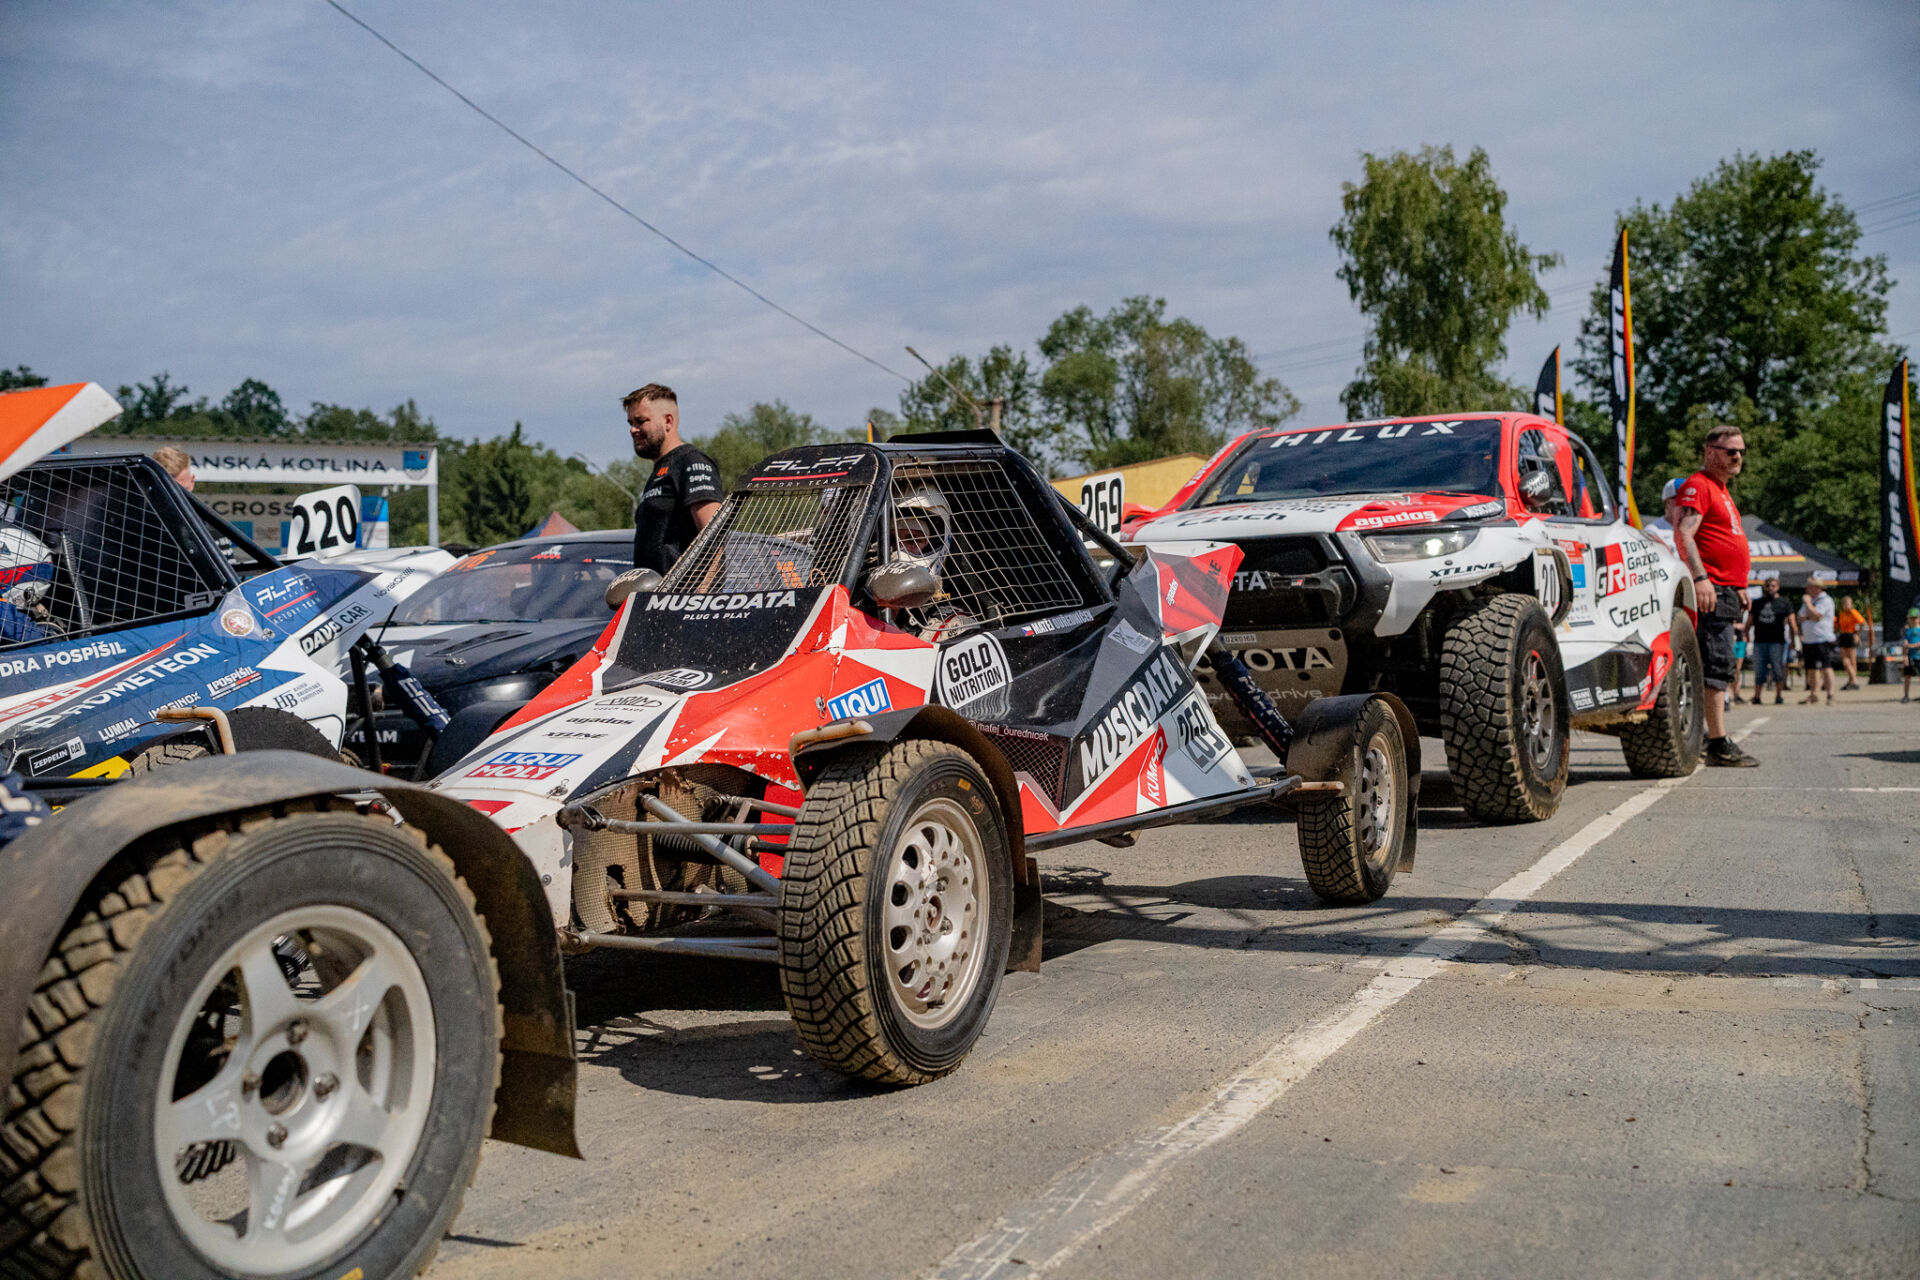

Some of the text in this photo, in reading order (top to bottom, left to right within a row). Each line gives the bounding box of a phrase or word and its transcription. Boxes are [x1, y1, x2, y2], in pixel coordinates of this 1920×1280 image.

[1270, 421, 1463, 448] HILUX
[282, 457, 387, 472] KOTLINA
[764, 454, 866, 472] ALFA
[809, 478, 839, 486] TEAM
[1081, 477, 1122, 542] 269
[1177, 512, 1287, 527] Czech
[1354, 510, 1437, 528] agados
[292, 495, 357, 555] 220
[1429, 562, 1504, 578] XTLINE
[1595, 562, 1627, 599] GR
[1629, 568, 1669, 587] Racing
[256, 573, 312, 606] ALFA
[1542, 563, 1557, 608] 20
[645, 590, 796, 611] MUSICDATA
[1609, 594, 1661, 628] Czech
[339, 605, 369, 625] CAR
[683, 613, 710, 621] PLUG
[725, 611, 751, 619] PLAY
[46, 640, 126, 668] POSPÍŠIL
[946, 642, 993, 683] GOLD
[20, 643, 220, 732] PROMETEON
[948, 665, 1003, 706] NUTRITION
[273, 691, 298, 709] HB
[832, 682, 888, 719] LIQUI
[98, 717, 140, 741] LUMIAL
[566, 717, 634, 725] agados
[1080, 652, 1183, 789] MUSICDATA
[33, 742, 82, 769] ZEPPELIN CAT
[496, 752, 577, 767] LIQUI
[470, 765, 559, 780] MOLY
[1147, 735, 1165, 802] KUMHO
